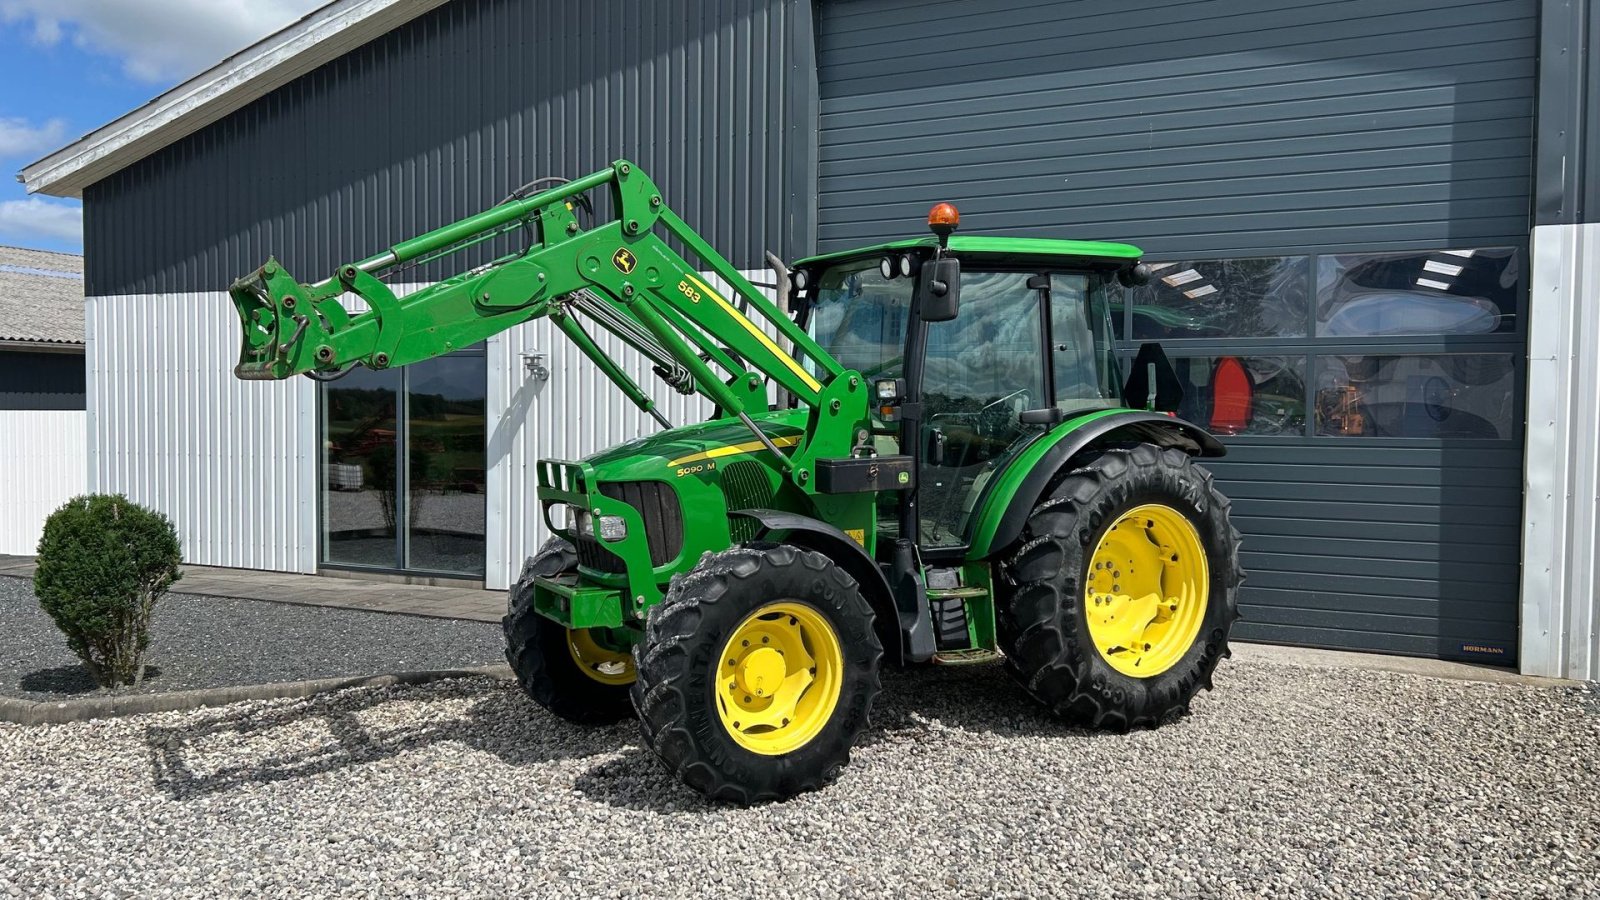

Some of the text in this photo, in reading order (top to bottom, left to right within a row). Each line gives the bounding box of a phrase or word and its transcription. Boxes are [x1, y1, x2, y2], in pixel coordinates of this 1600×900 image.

[677, 280, 701, 304] 583
[677, 462, 715, 477] 5090 M
